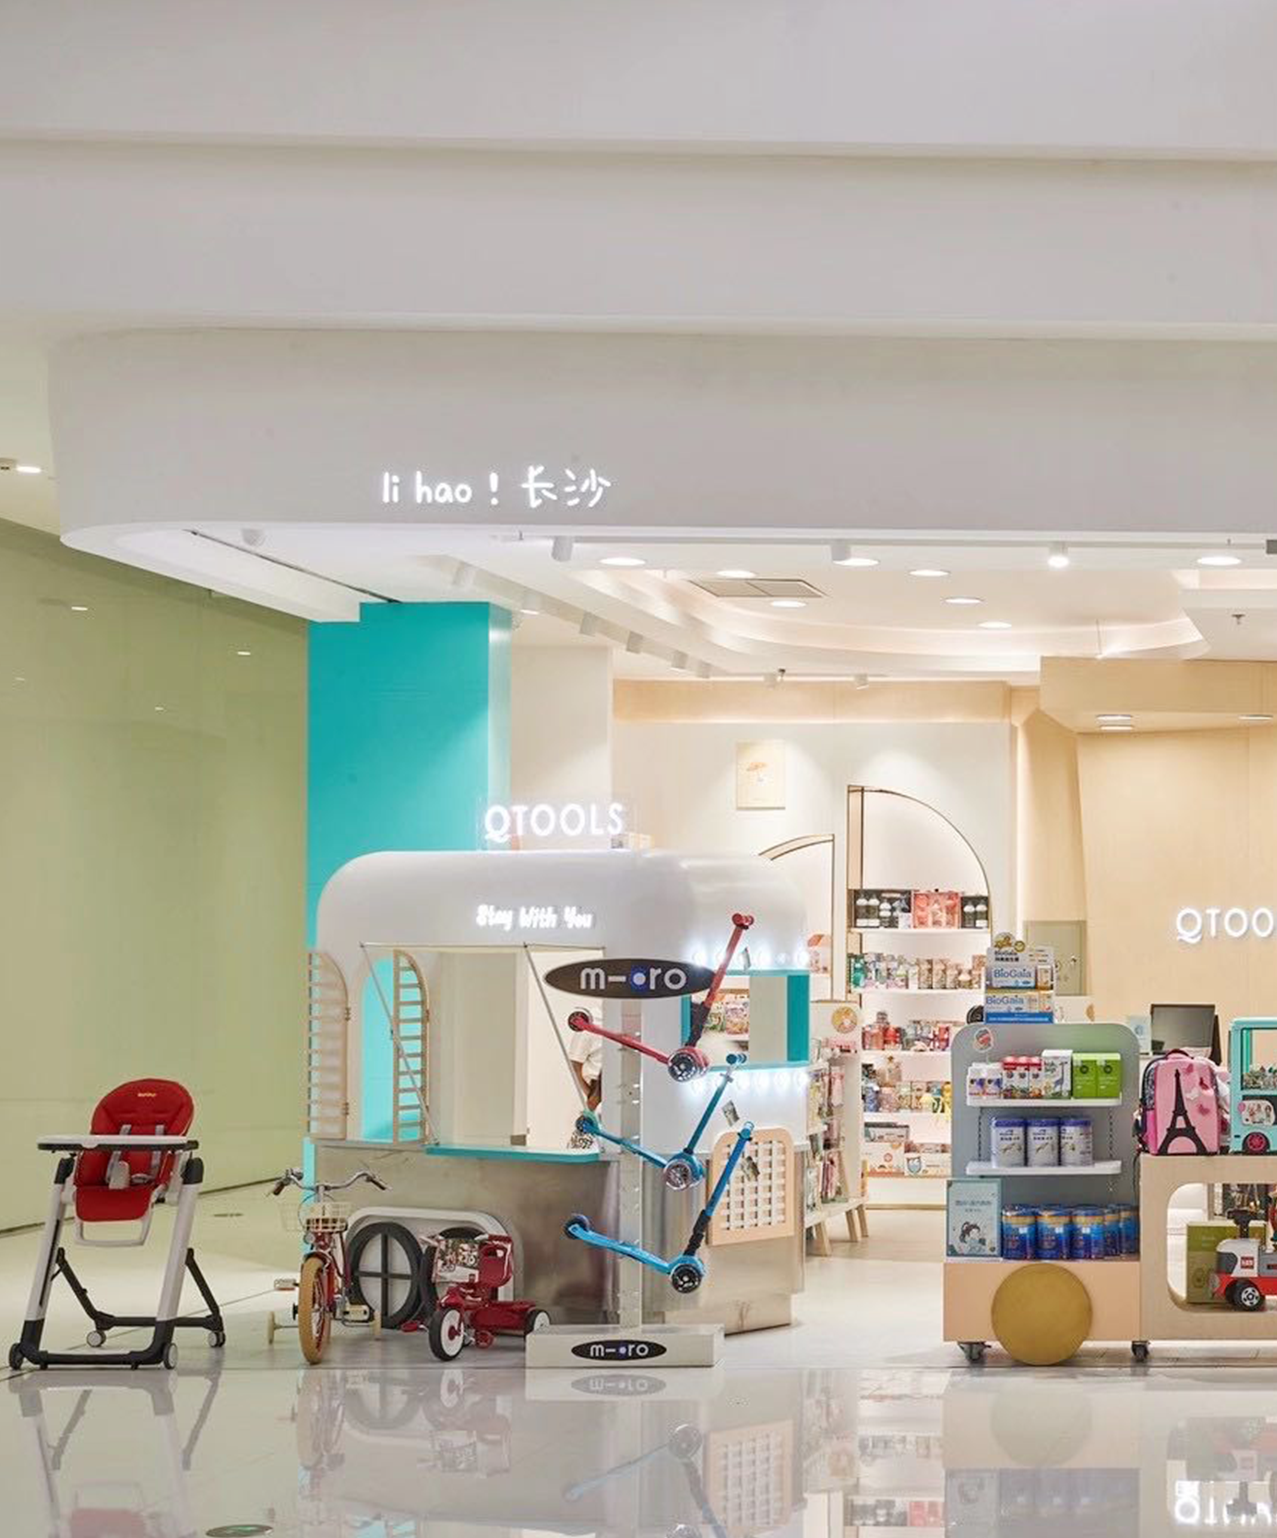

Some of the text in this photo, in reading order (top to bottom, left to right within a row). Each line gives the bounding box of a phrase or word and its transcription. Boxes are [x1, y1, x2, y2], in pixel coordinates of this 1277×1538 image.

[382, 471, 400, 503] li
[521, 465, 611, 508] 长沙
[484, 803, 624, 843] QTOOLS
[476, 904, 593, 931] Stay With You
[994, 968, 1032, 978] BioGaia
[986, 995, 1024, 1005] BioGaia
